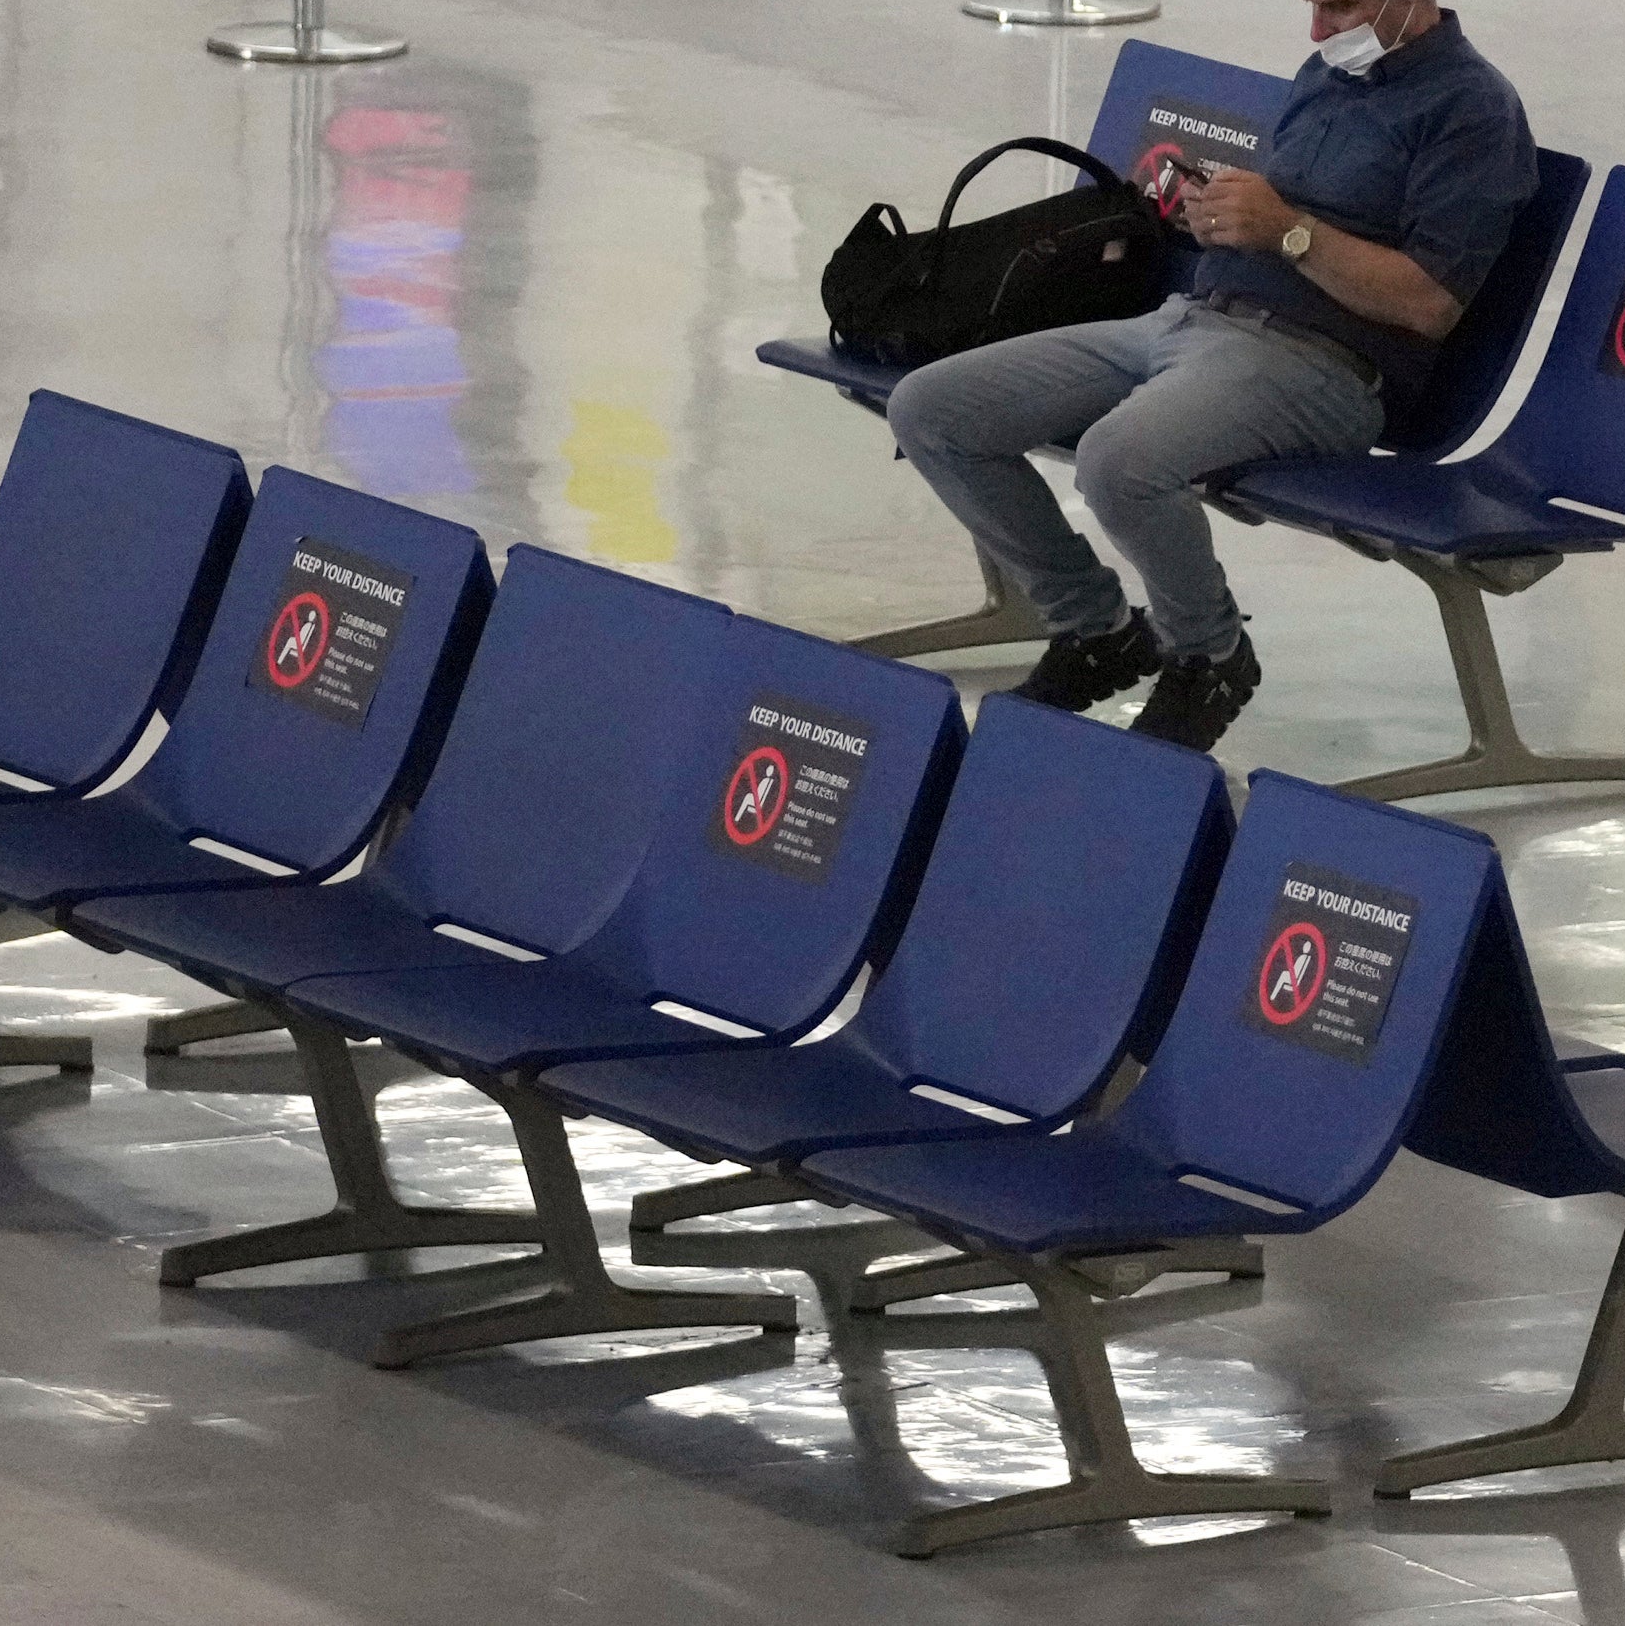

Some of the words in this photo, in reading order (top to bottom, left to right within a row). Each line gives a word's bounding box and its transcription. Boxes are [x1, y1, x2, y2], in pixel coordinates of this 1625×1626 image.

[1149, 108, 1177, 126] KEEP
[1178, 116, 1208, 136] YOUR
[1207, 124, 1259, 150] DISTANCE
[293, 551, 322, 573] KEEP
[322, 561, 356, 587] YOUR
[352, 574, 405, 606] DISTANCE
[749, 706, 779, 728] KEEP
[780, 715, 812, 739] YOUR
[812, 726, 867, 756] DISTANCE
[1284, 879, 1315, 902] KEEP
[1316, 889, 1351, 913] YOUR
[1351, 900, 1411, 932] DISTANCE
[1326, 978, 1346, 993] Please
[1345, 985, 1356, 996] do
